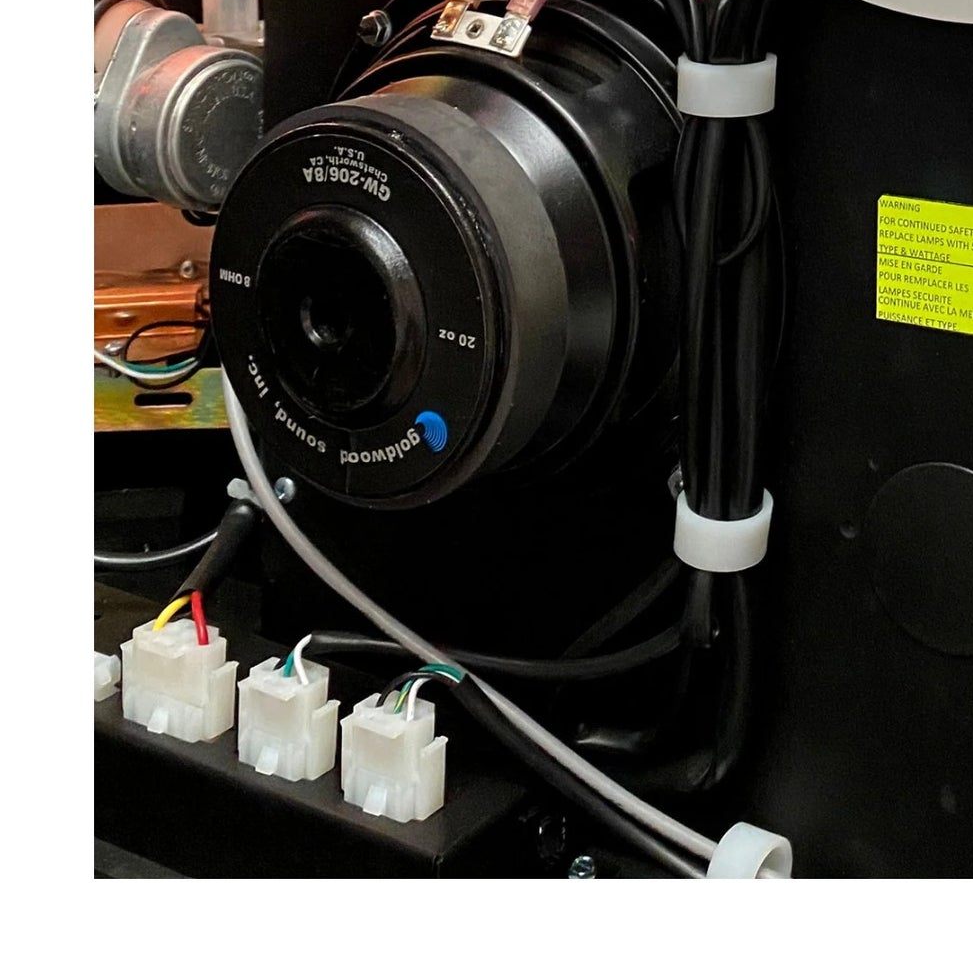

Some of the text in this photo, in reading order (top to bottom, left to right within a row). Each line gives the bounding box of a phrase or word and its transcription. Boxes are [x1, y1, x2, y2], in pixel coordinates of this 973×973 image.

[334, 146, 364, 160] U.S.A.
[309, 156, 388, 182] Chatsworth, CA
[303, 167, 390, 201] GW-206/8A
[880, 200, 920, 212] WARNING
[880, 216, 896, 225] FOR
[898, 218, 946, 232] CONTINUED
[880, 231, 914, 242] REPLACE
[916, 235, 944, 246] LAMPS
[946, 239, 969, 249] WITH
[880, 245, 950, 262] TYPE & WATTAGE
[880, 259, 942, 274] MISE EN GARDE
[219, 268, 243, 284] OHM
[879, 272, 969, 292] POUR REMPLACER LES
[879, 287, 952, 305] LAMPES SECURITE
[879, 296, 920, 309] CONTINUE
[923, 303, 945, 313] AVEC
[947, 306, 956, 316] LA
[879, 311, 957, 330] PUISSANCE ET TYPE
[438, 329, 476, 348] 20 oz
[247, 354, 420, 465] goldwood sound, inc.
